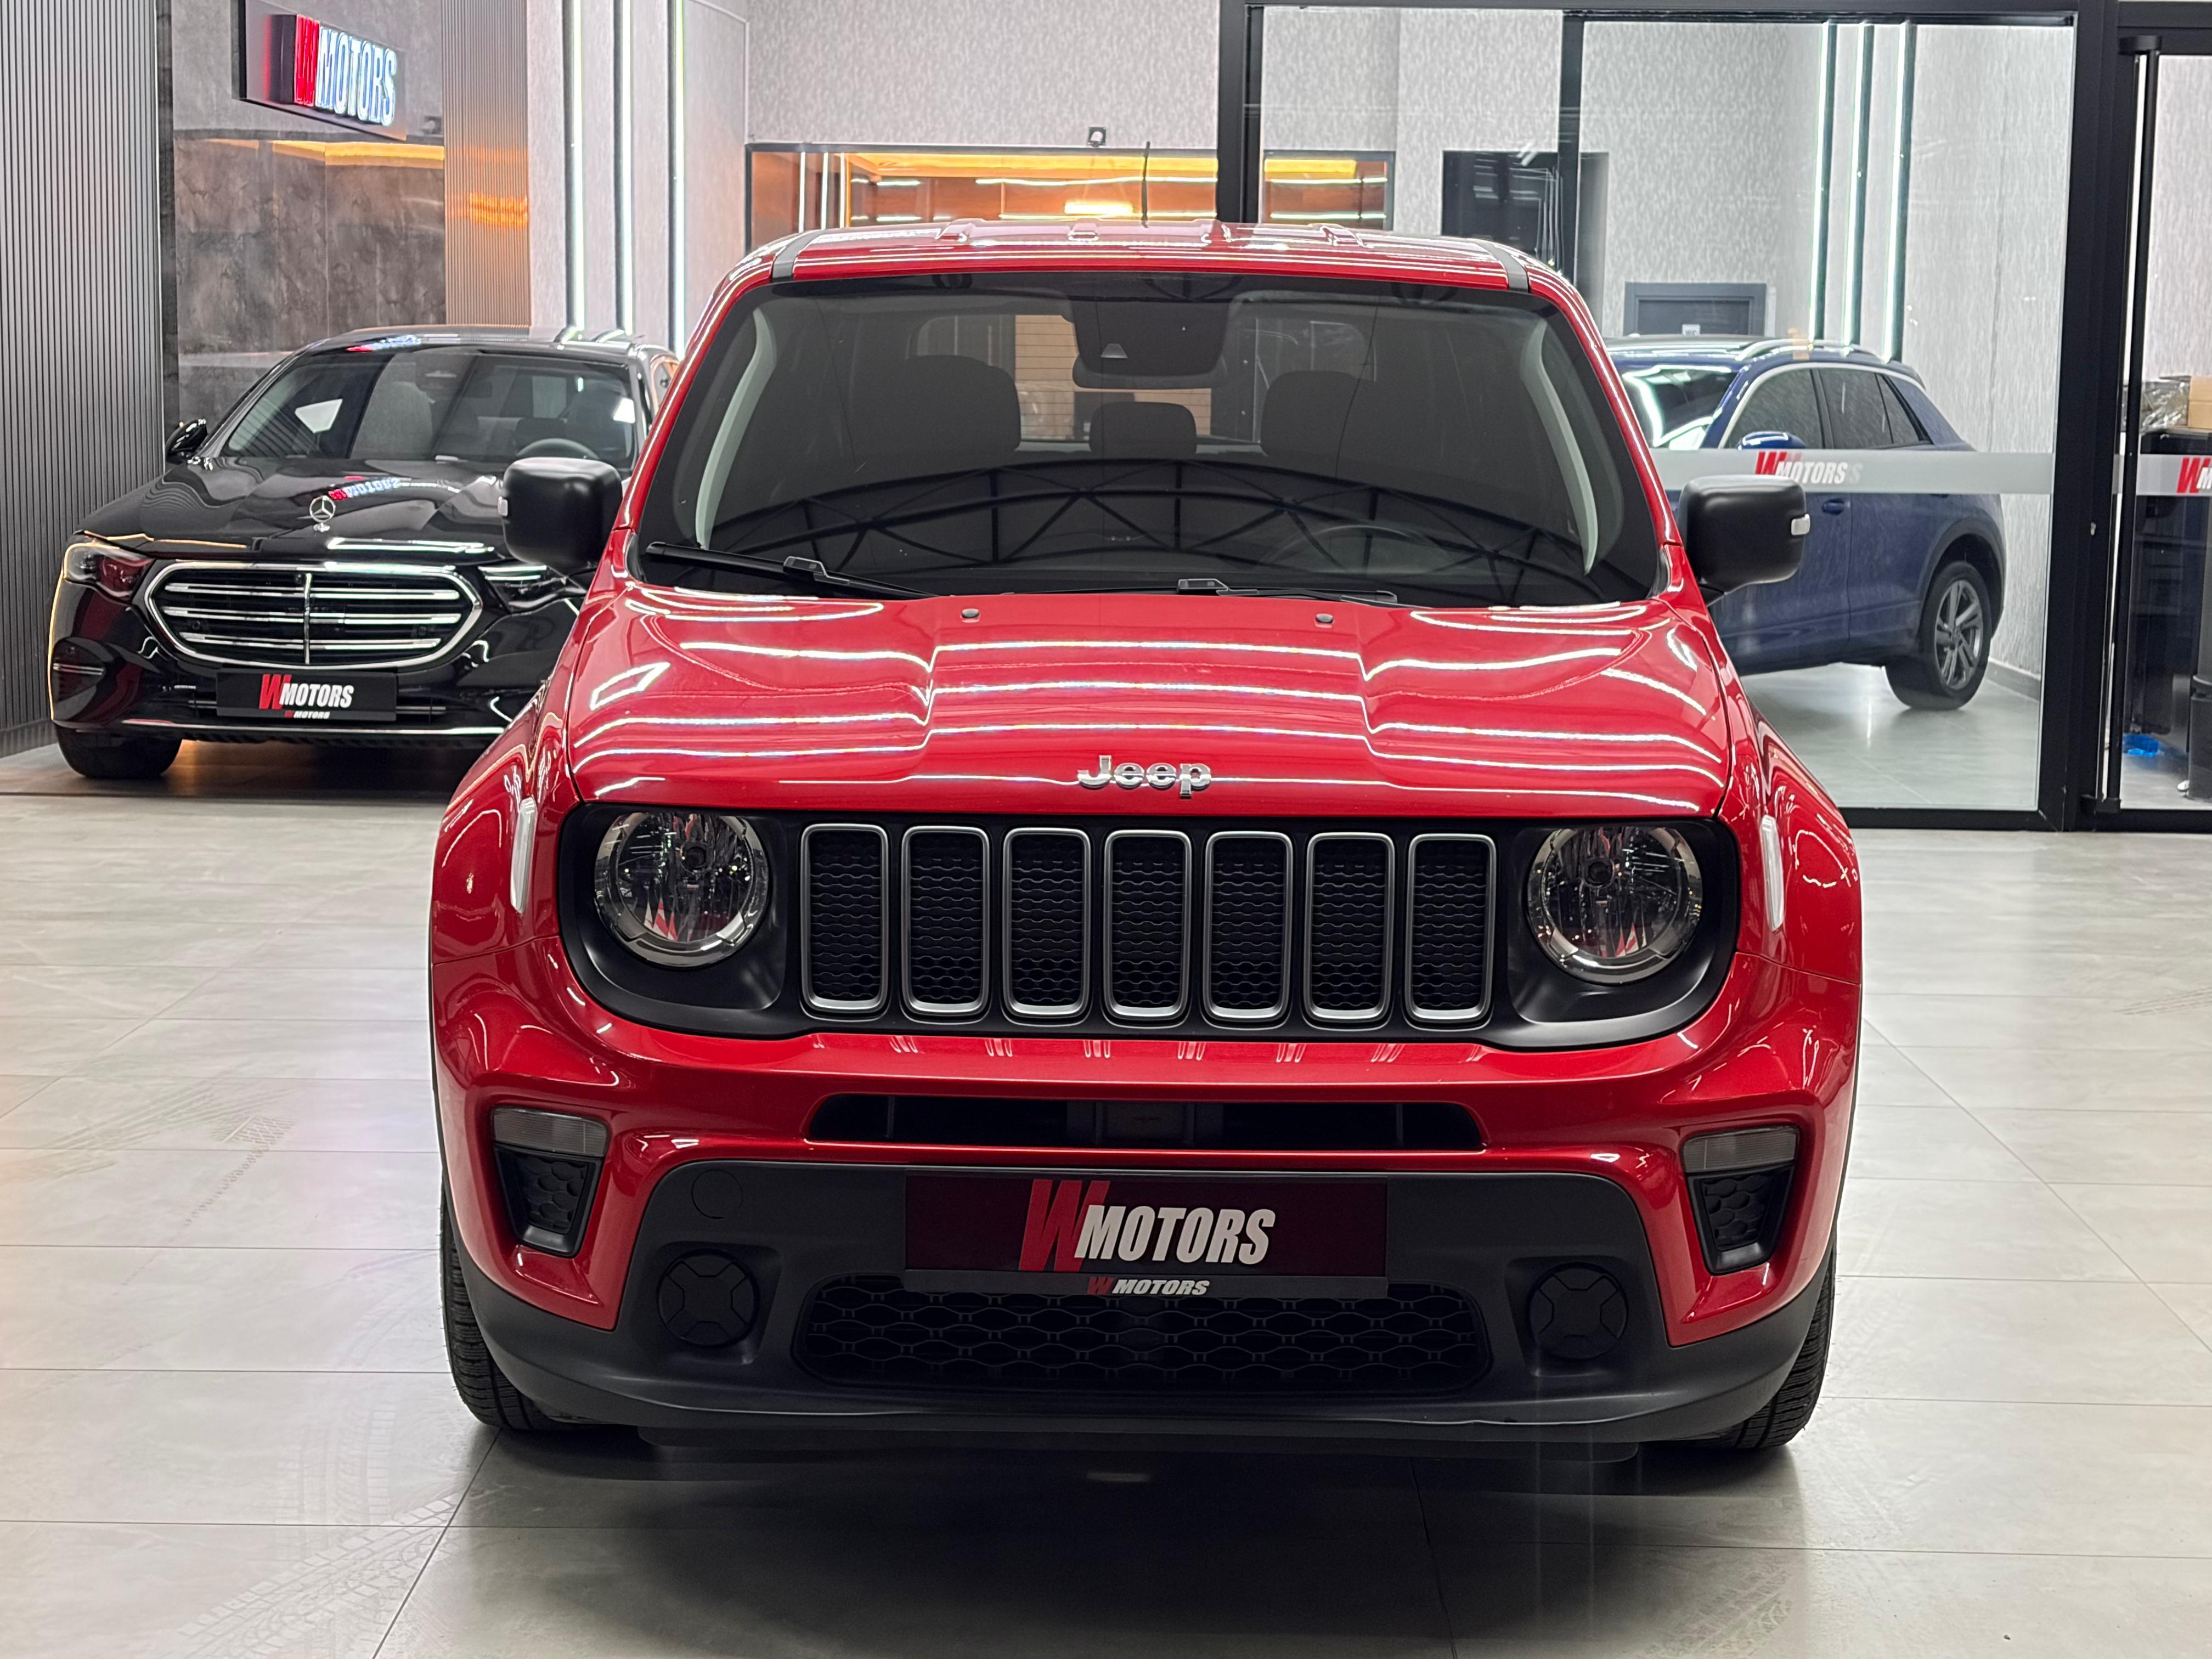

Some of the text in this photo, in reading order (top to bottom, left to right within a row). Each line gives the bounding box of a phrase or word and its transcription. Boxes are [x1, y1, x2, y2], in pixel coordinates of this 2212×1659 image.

[1077, 755, 1212, 799] Jeep
[1075, 1205, 1276, 1265] MOTORS
[1112, 1279, 1210, 1295] MOTORS
